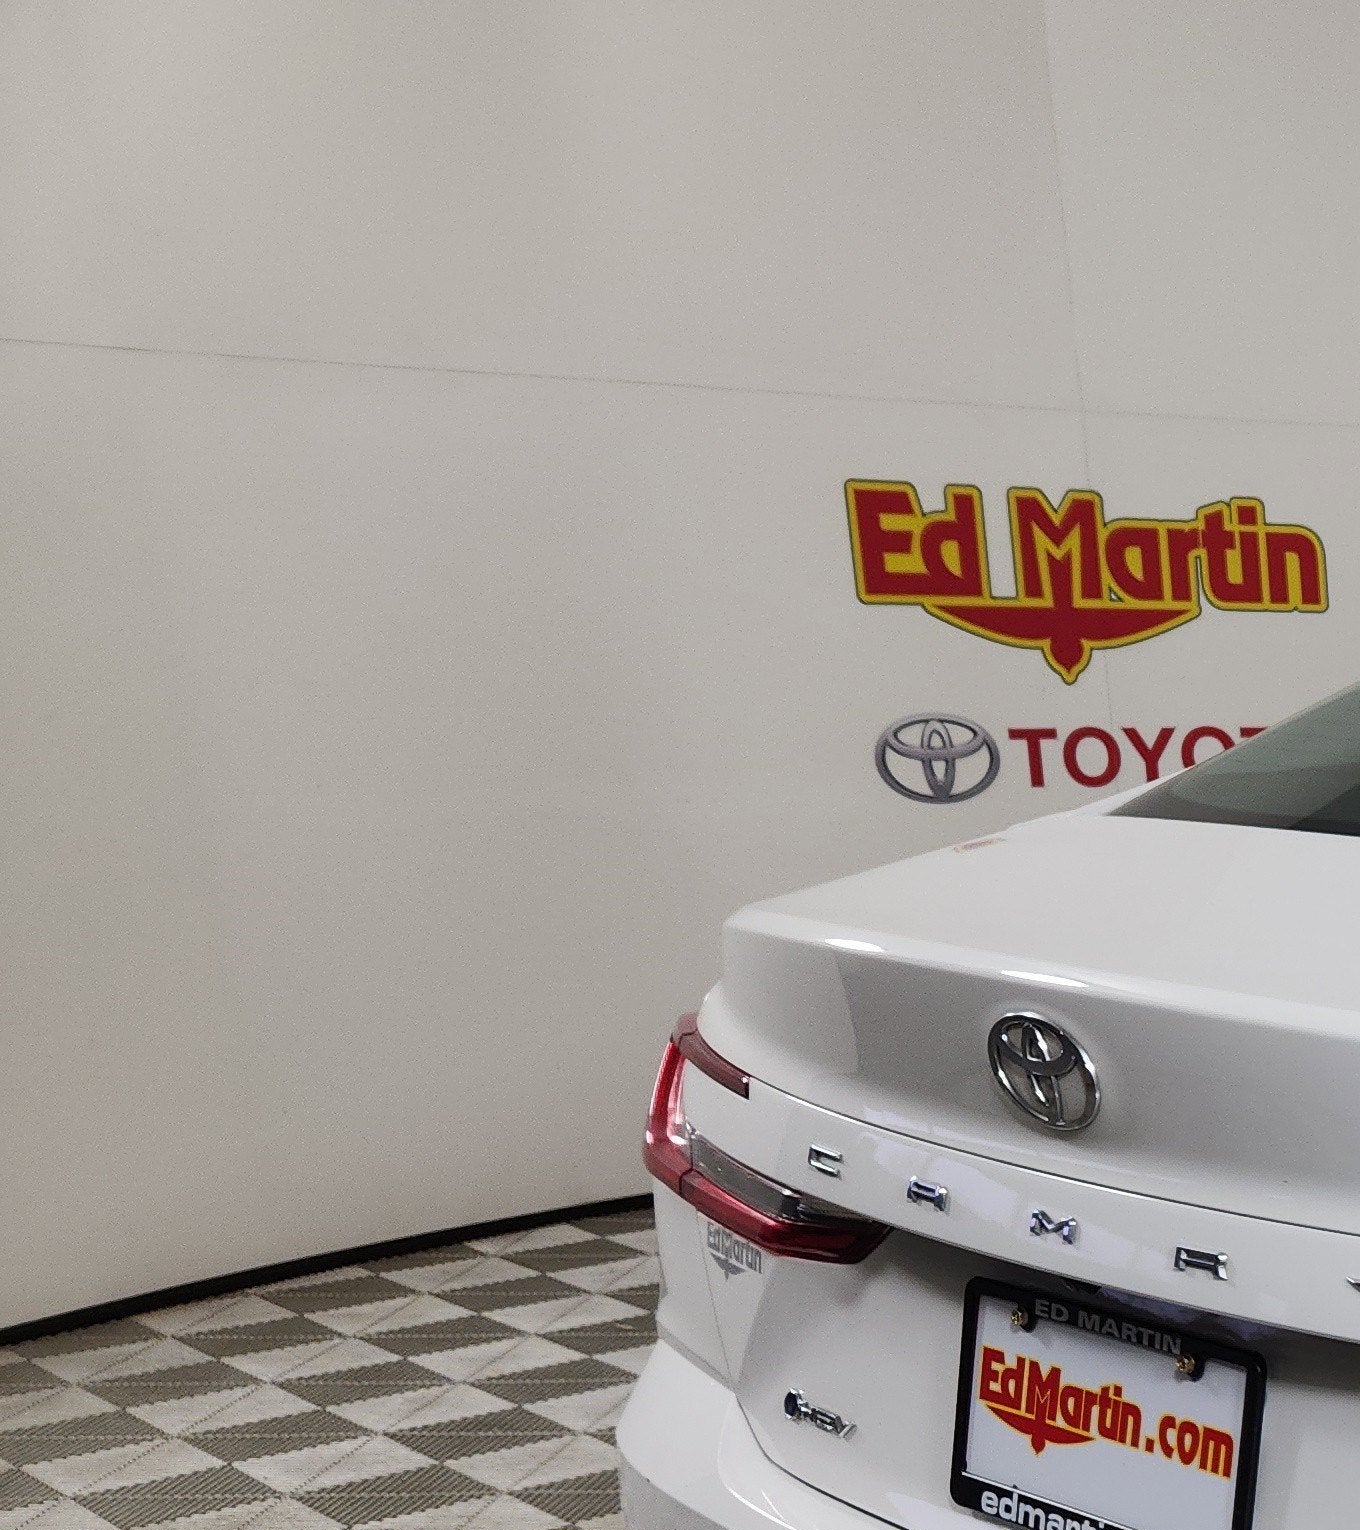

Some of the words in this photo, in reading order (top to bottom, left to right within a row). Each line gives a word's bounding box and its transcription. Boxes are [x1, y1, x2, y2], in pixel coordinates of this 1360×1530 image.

[845, 479, 989, 605] Ed
[1007, 486, 1329, 613] Martin
[1007, 725, 1267, 789] TOYO
[1034, 1300, 1069, 1323] ED
[1076, 1309, 1183, 1355] MARTIN
